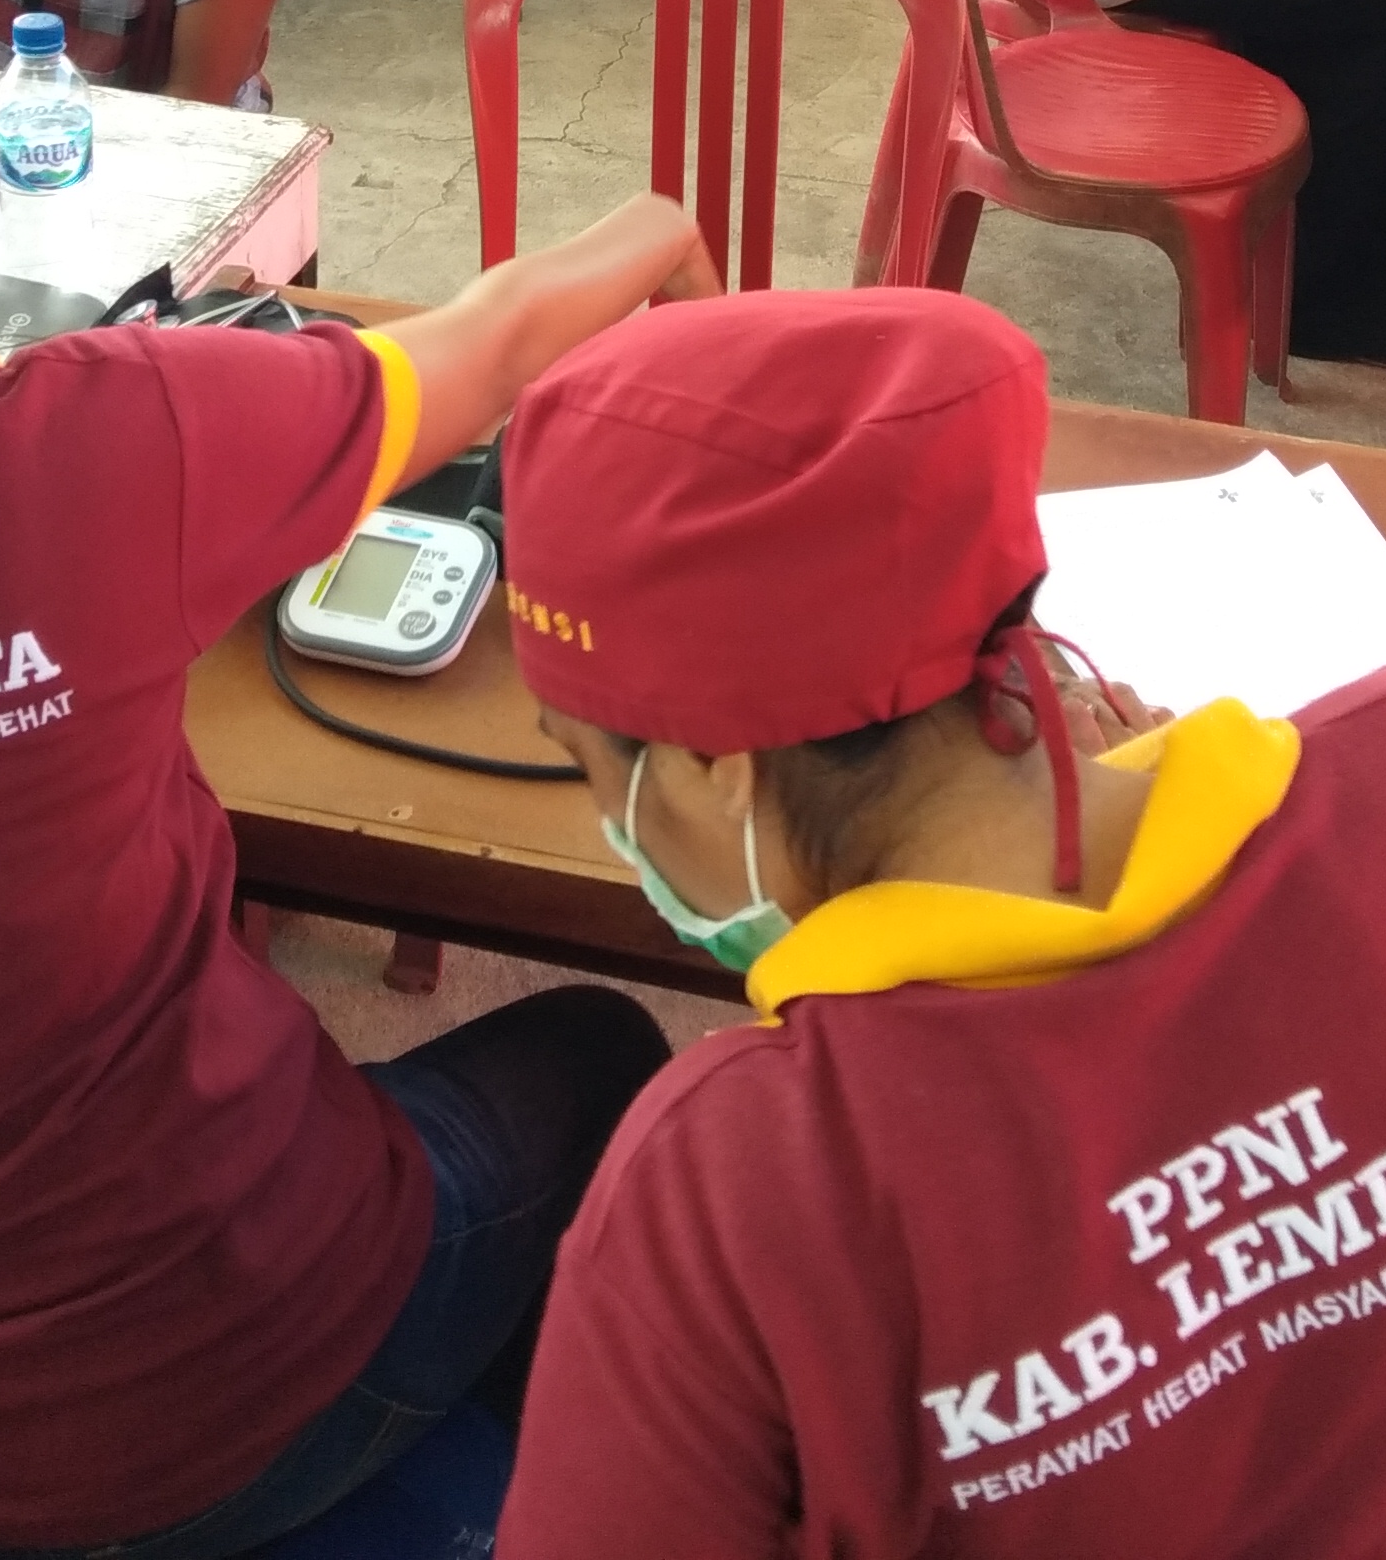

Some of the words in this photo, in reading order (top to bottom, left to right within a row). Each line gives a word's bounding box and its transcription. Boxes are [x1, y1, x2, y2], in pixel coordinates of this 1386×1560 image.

[16, 139, 80, 168] AQUA
[409, 569, 433, 583] DIA
[420, 548, 449, 562] SYS
[1106, 1086, 1348, 1265] PPNI
[920, 1312, 1158, 1461] KAB.
[950, 1412, 1133, 1511] PERAWAT
[1141, 1335, 1251, 1429] HEBAT
